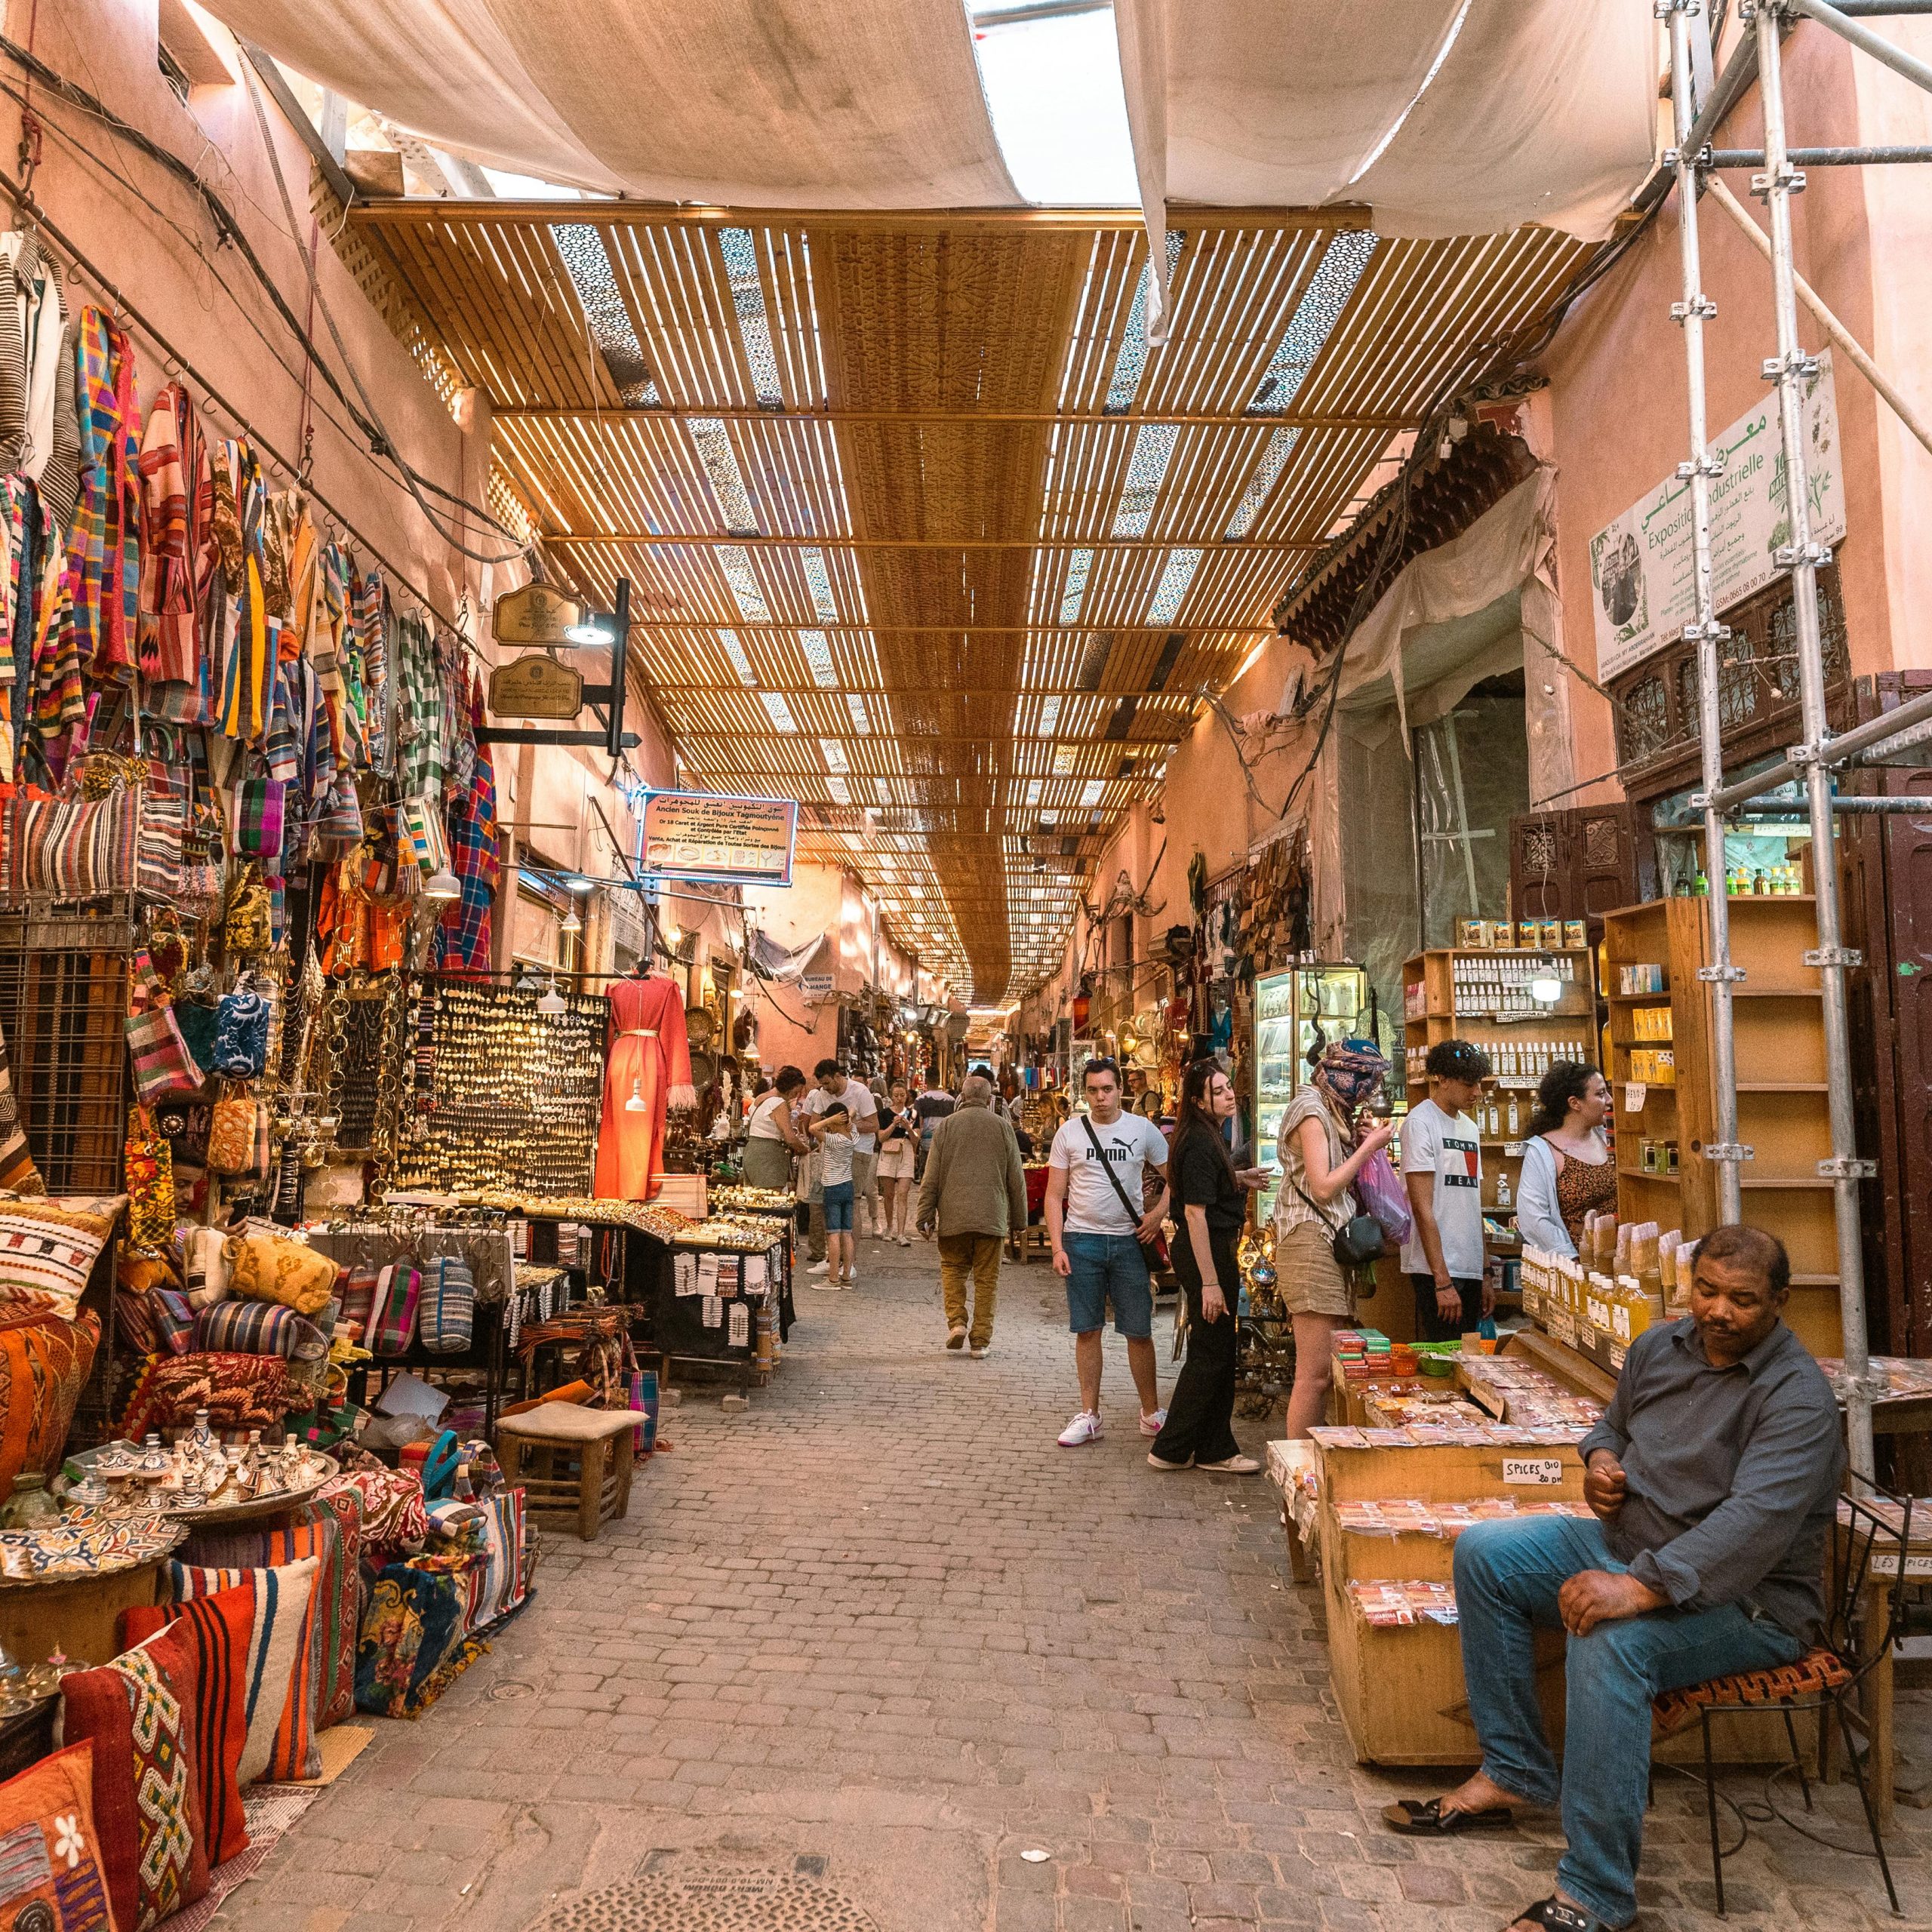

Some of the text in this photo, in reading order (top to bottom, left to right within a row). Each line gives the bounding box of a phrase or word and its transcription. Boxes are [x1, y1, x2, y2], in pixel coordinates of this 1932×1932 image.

[1648, 452, 1764, 549] Expositio ndustrielle
[736, 811, 784, 820] Tagmoutyène
[1087, 1148, 1126, 1161] PMA
[1506, 1461, 1559, 1475] SPICES BIO
[1539, 1474, 1549, 1483] 20
[1873, 1555, 1894, 1569] LES
